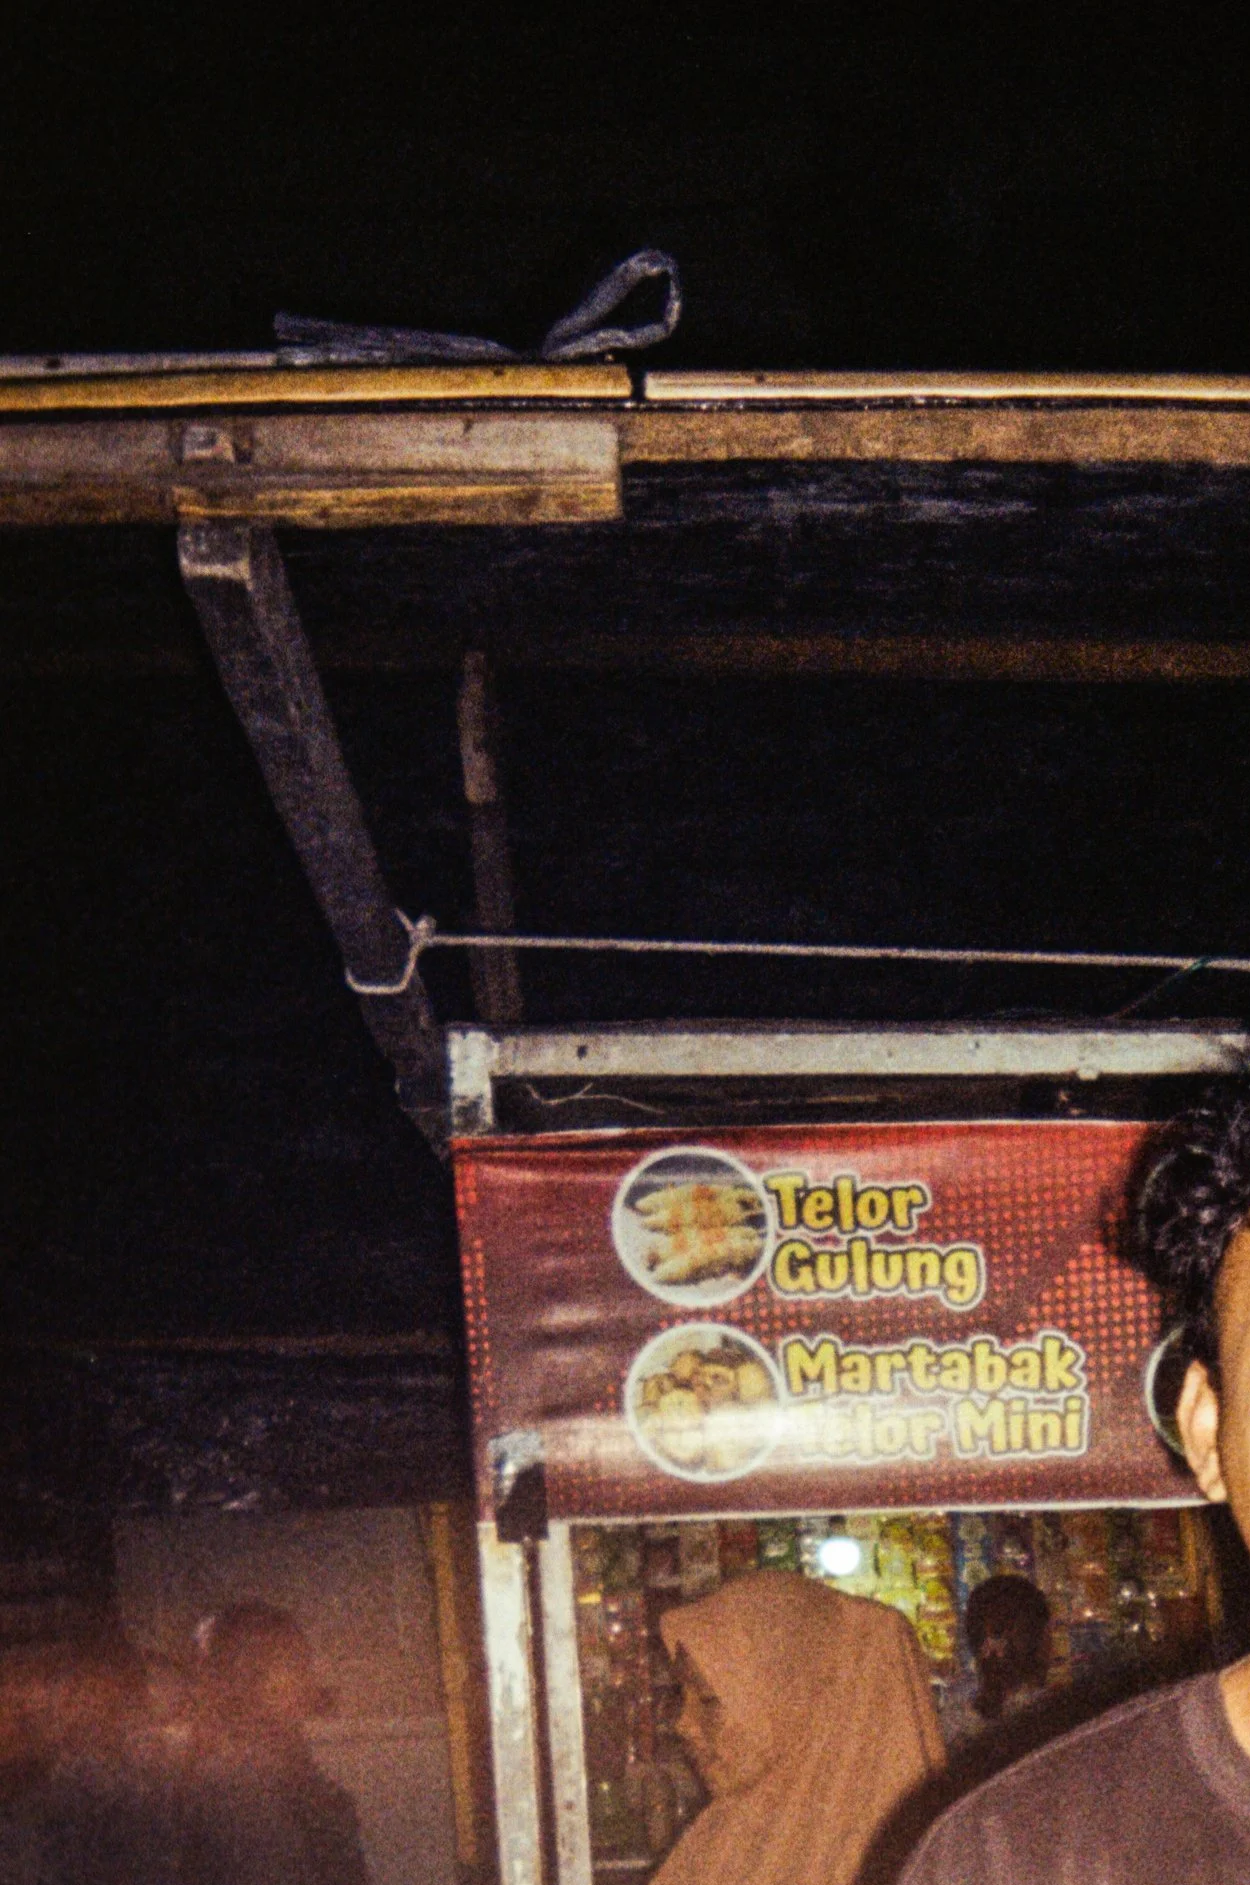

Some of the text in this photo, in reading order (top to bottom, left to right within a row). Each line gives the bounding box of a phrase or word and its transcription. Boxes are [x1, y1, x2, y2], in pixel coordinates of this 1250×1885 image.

[763, 1171, 927, 1234] Telor
[772, 1238, 981, 1306] Gulung
[784, 1335, 1081, 1396] Martabak
[955, 1393, 1084, 1453] Mini
